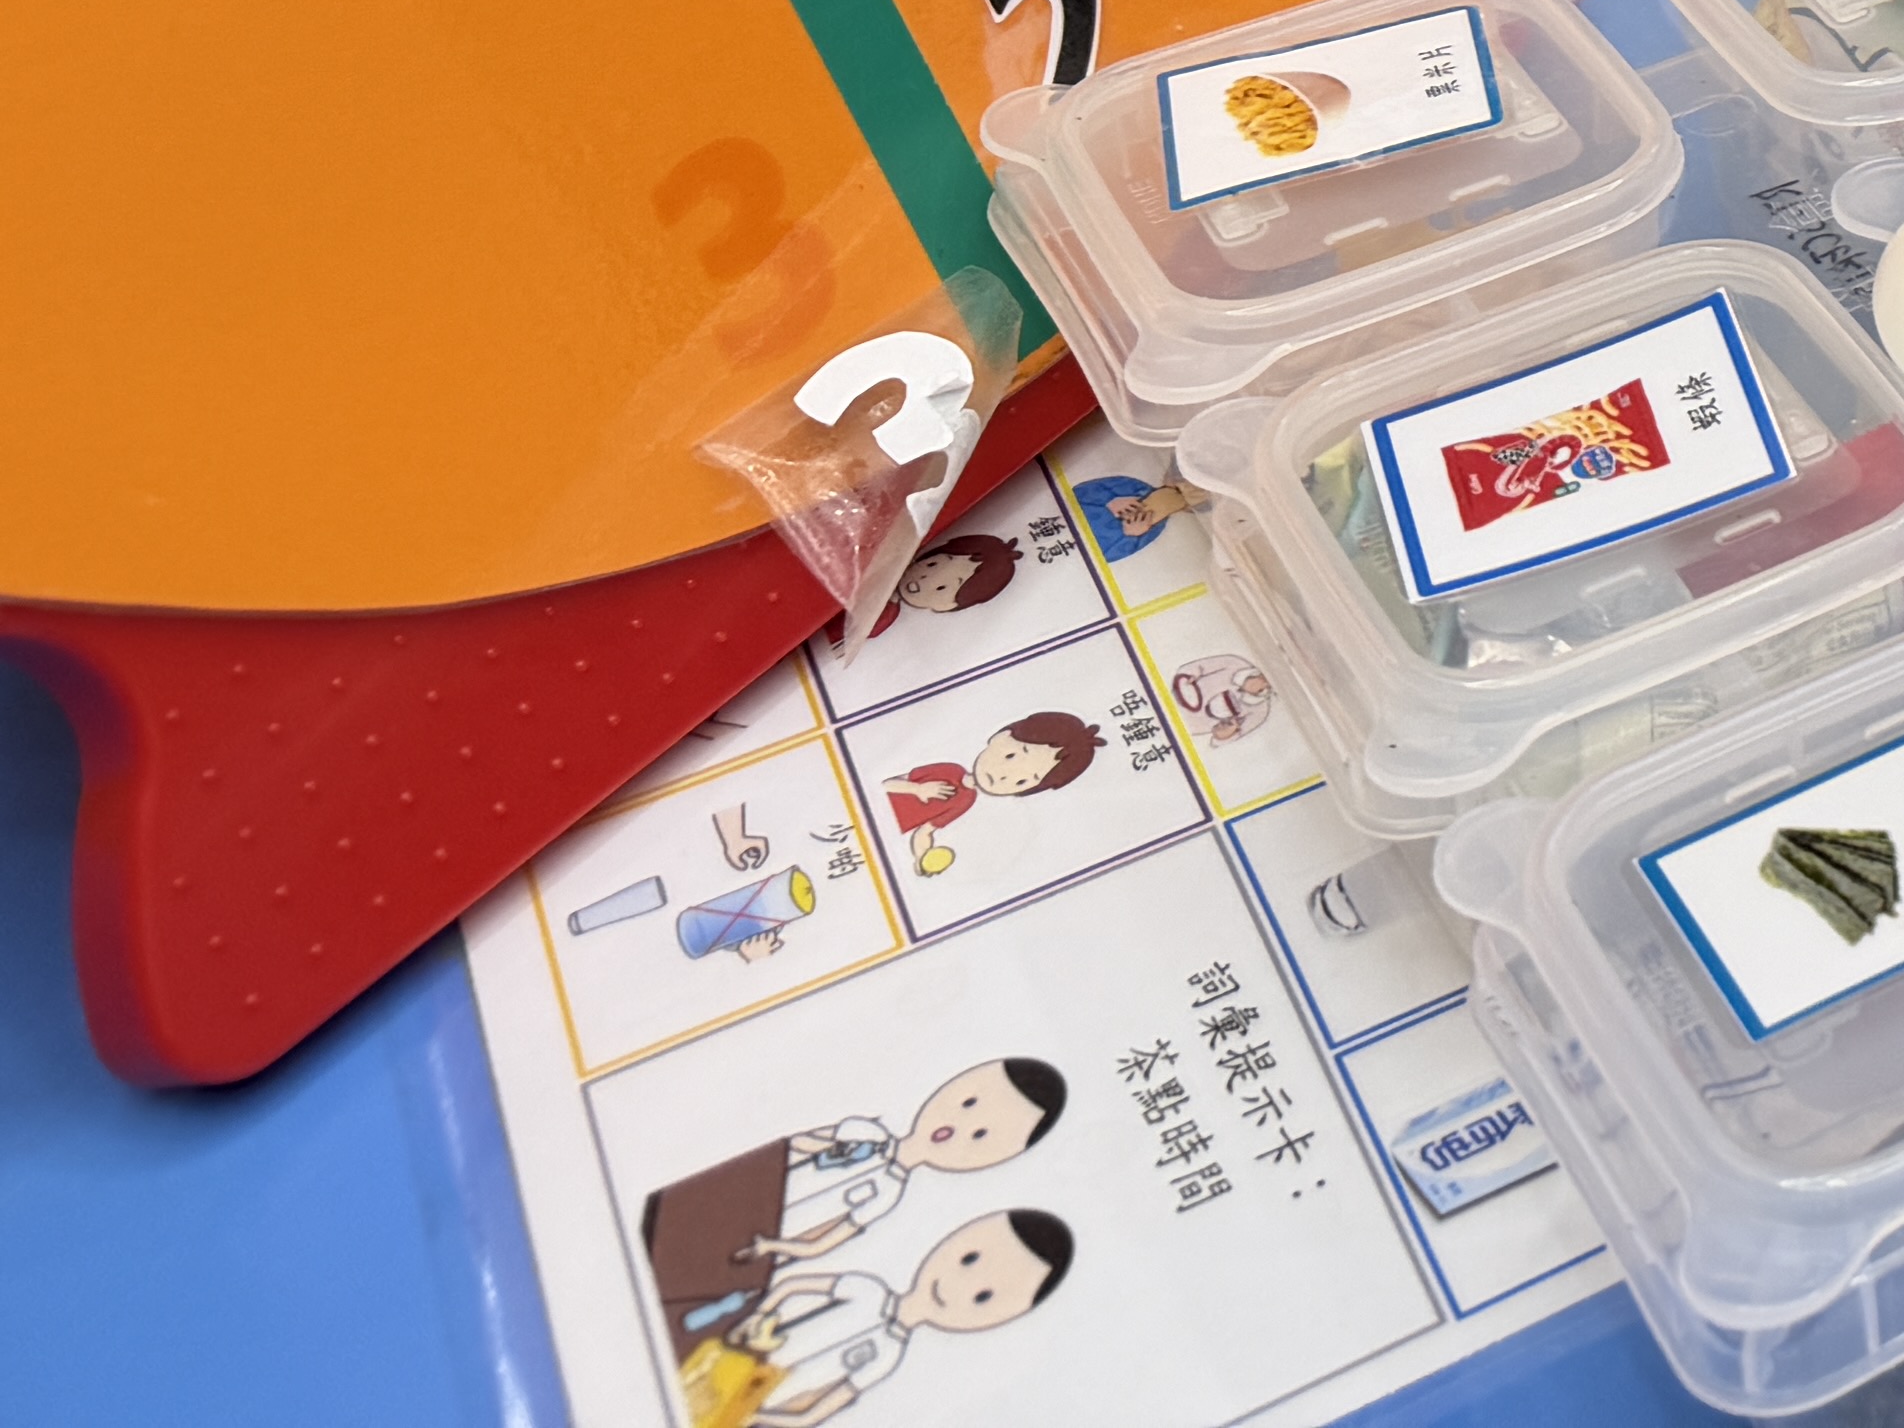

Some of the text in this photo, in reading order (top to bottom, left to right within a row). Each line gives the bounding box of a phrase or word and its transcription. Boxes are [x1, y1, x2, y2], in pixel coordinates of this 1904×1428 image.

[1674, 370, 1723, 432] 蝦條
[1028, 515, 1077, 564] 鍾意
[1110, 689, 1173, 771] 唔鍾意
[1116, 1038, 1233, 1214] 茶點時間
